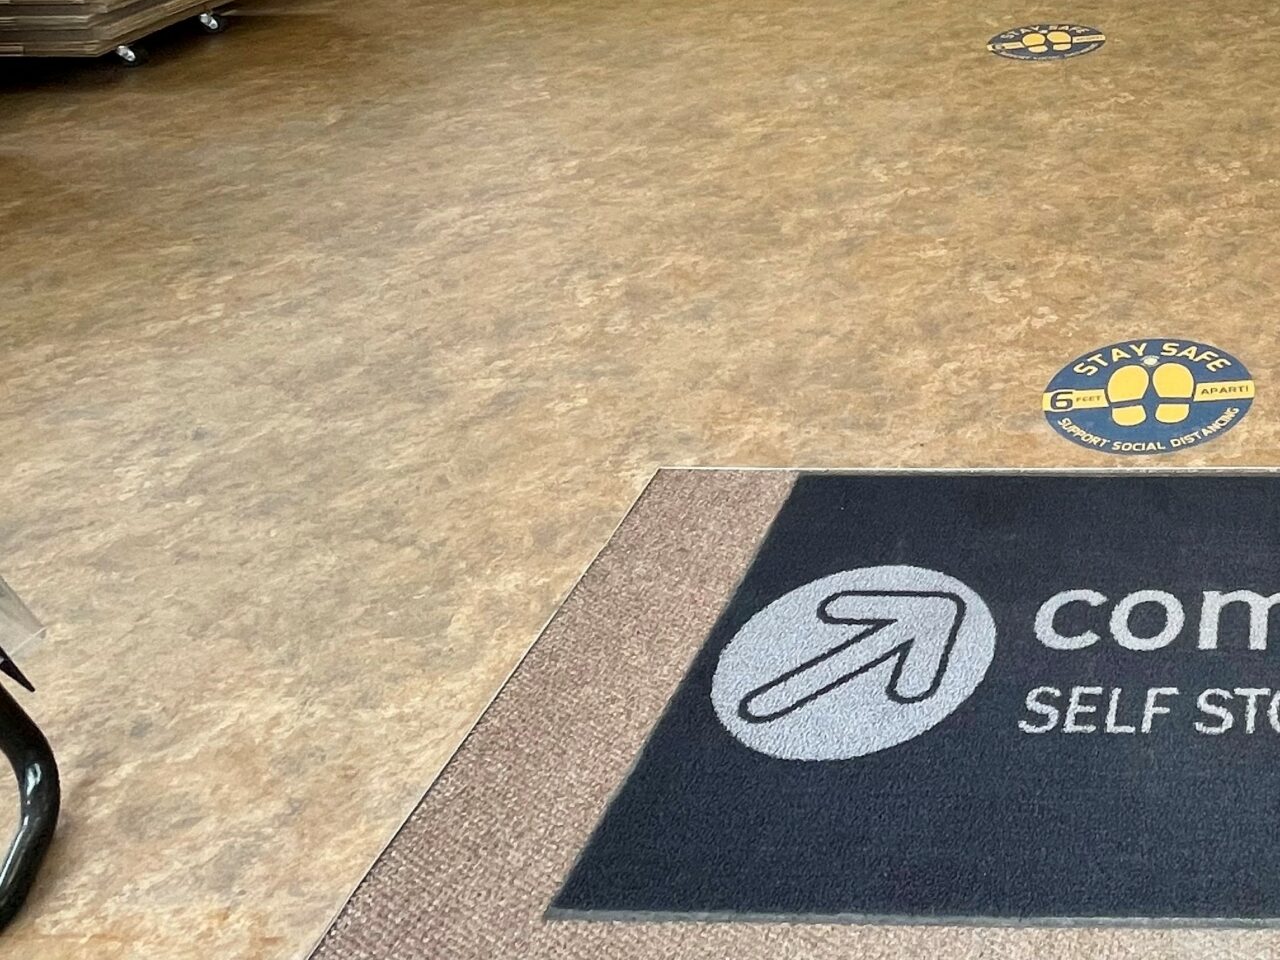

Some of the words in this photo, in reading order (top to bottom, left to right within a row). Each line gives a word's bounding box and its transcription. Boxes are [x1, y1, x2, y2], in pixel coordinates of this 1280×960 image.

[1073, 342, 1148, 376] STAY
[1160, 342, 1232, 372] SAFE
[1050, 390, 1075, 411] 6
[1076, 395, 1102, 403] FEET
[1200, 385, 1250, 396] APART!
[1057, 417, 1110, 448] SUPPORT
[1112, 440, 1165, 452] SOCIAL
[1169, 407, 1240, 448] DISTANCING
[1018, 686, 1180, 734] SELF
